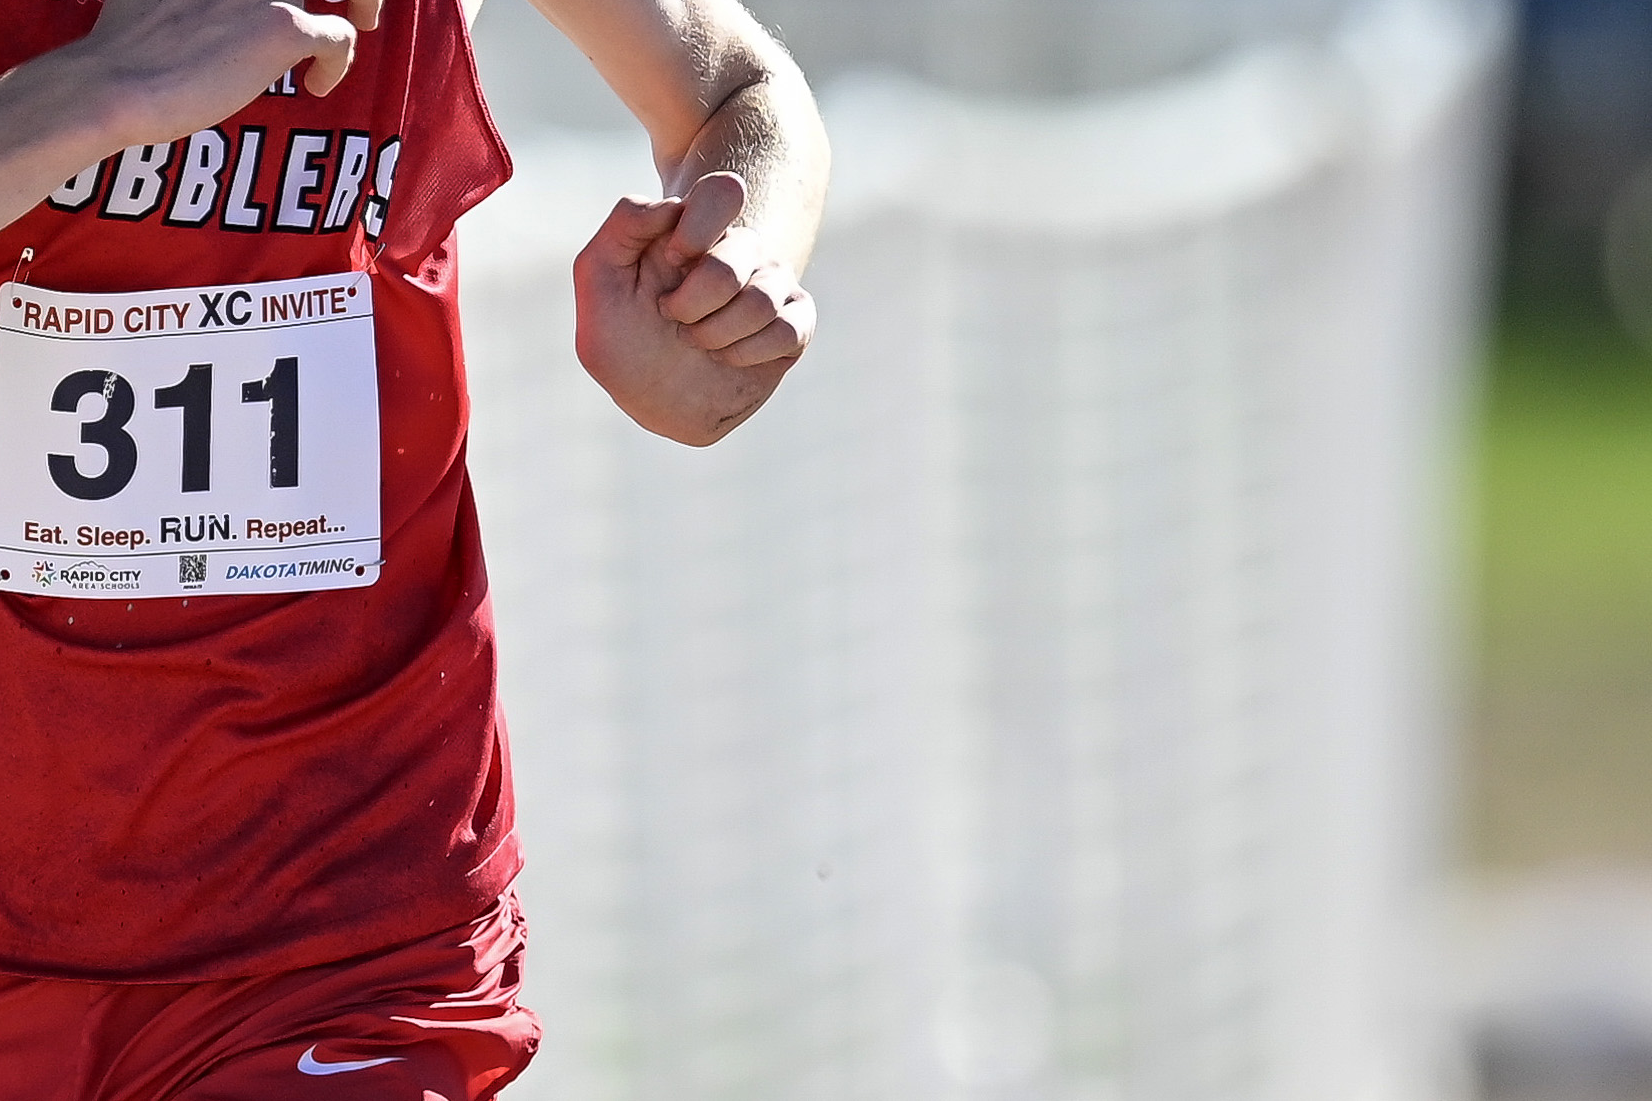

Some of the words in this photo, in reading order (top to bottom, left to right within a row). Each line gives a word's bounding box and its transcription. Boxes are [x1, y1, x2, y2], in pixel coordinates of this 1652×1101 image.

[23, 301, 115, 334] RAPID
[123, 302, 191, 333] CITY
[198, 290, 253, 328] XC
[261, 286, 347, 323] INVITE
[47, 356, 299, 501] 311
[24, 521, 68, 545] Eat.
[76, 525, 151, 550] Sleep.
[160, 514, 237, 544] RUN.
[247, 514, 346, 543] Repeat...
[60, 570, 106, 584] RAPID
[109, 570, 141, 582] CITY
[225, 558, 354, 580] DAKOTATIMING
[71, 582, 97, 590] AREA
[100, 582, 140, 590] SCHOOLS
